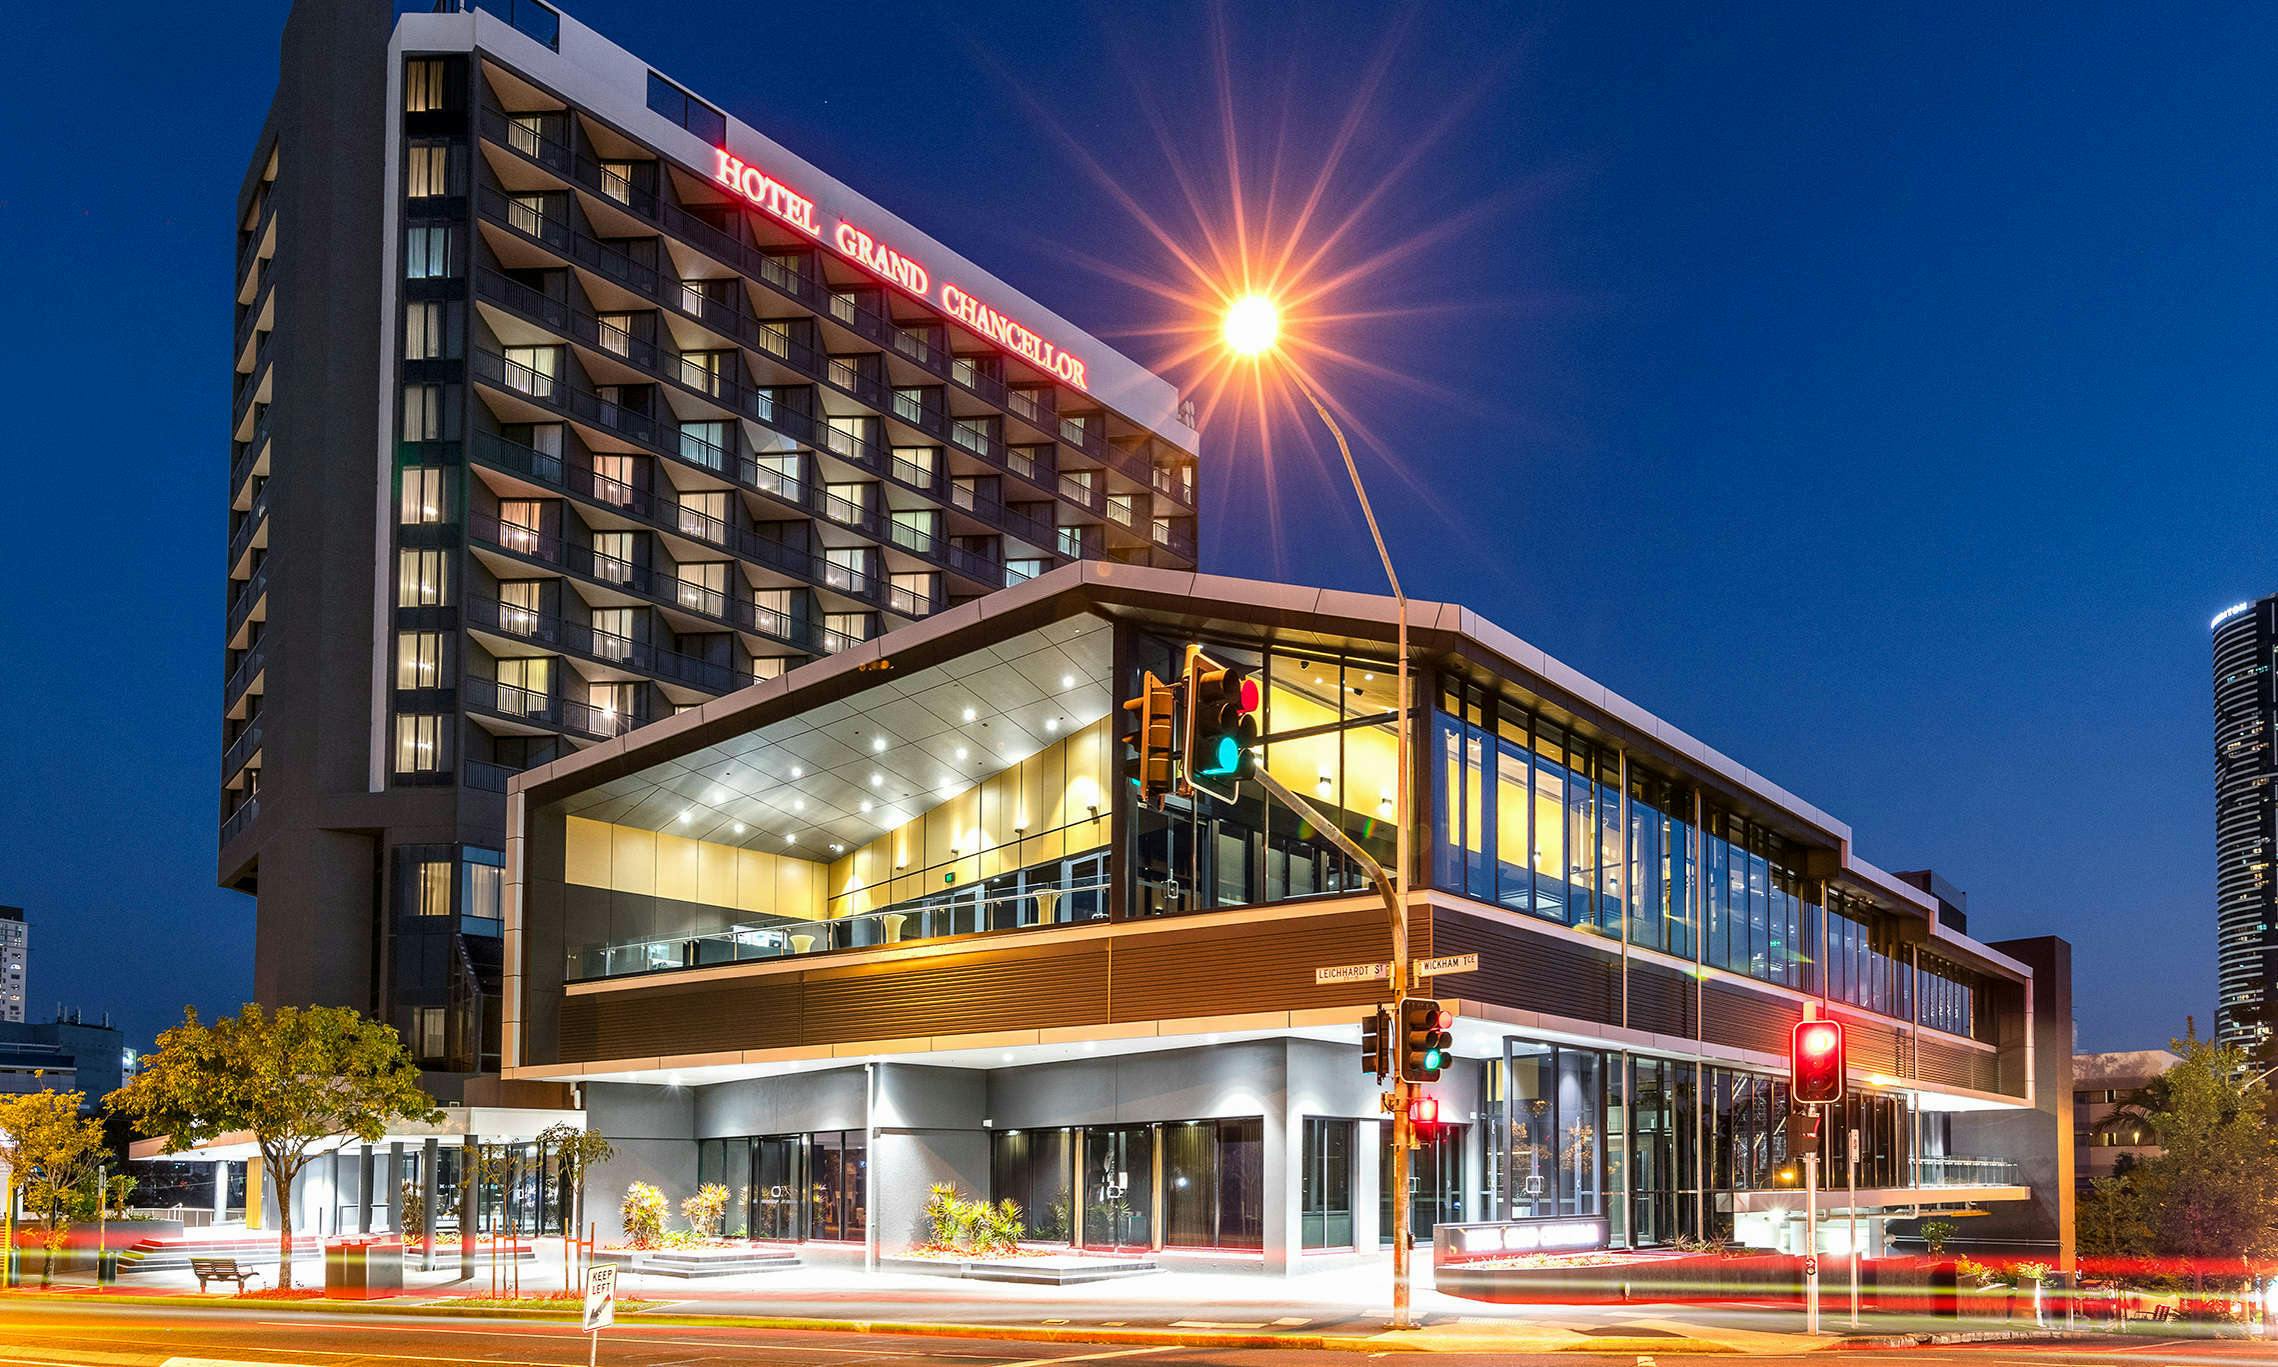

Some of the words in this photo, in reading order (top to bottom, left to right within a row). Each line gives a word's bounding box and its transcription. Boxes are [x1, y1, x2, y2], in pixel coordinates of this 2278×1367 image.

[715, 147, 821, 237] HOTEL
[835, 221, 929, 296] GRAND
[941, 282, 1089, 391] CHANCELLOR
[1423, 957, 1459, 970] WICKHAM
[1318, 965, 1369, 979] LEICHHARDT
[593, 1270, 613, 1282] KEEP
[592, 1282, 611, 1295] LEFT
